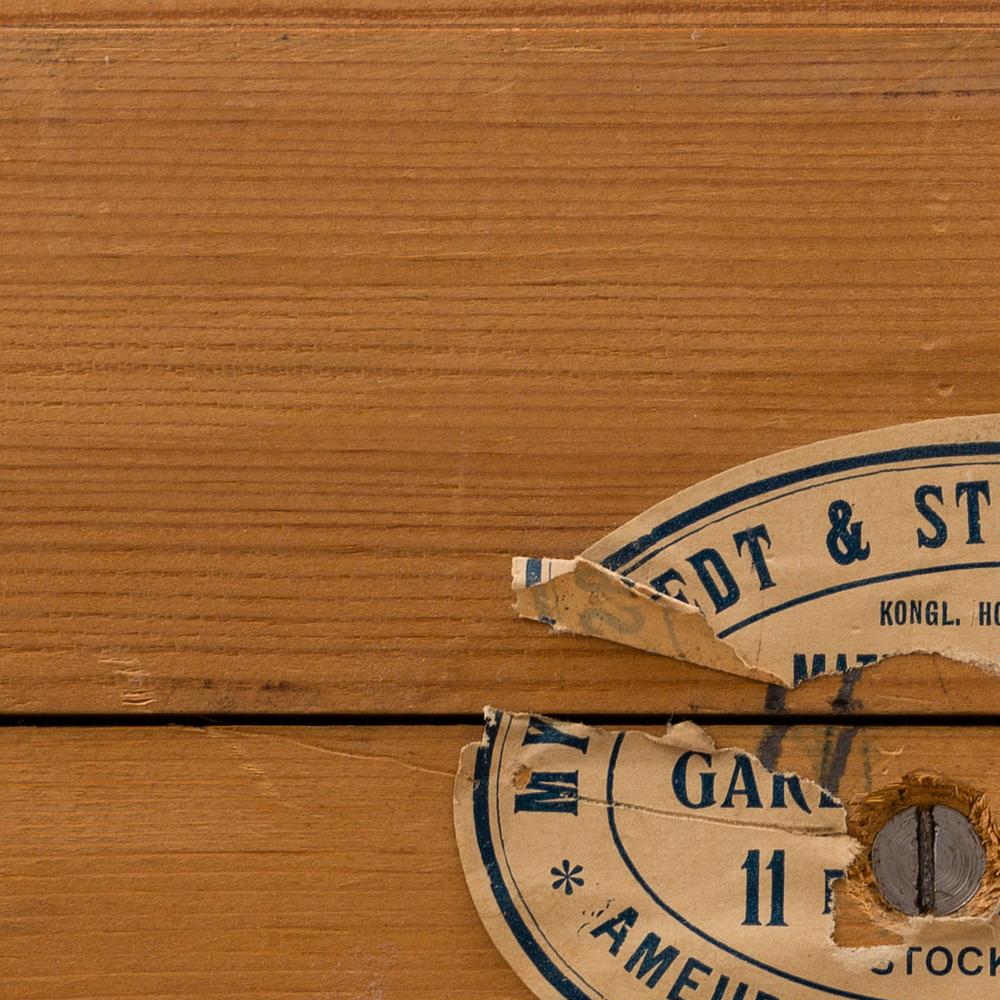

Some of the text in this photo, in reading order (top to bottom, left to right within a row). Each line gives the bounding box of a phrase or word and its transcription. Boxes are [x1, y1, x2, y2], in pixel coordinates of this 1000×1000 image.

[825, 499, 871, 566] &
[880, 599, 962, 627] KONGL.
[741, 849, 788, 927] 11
